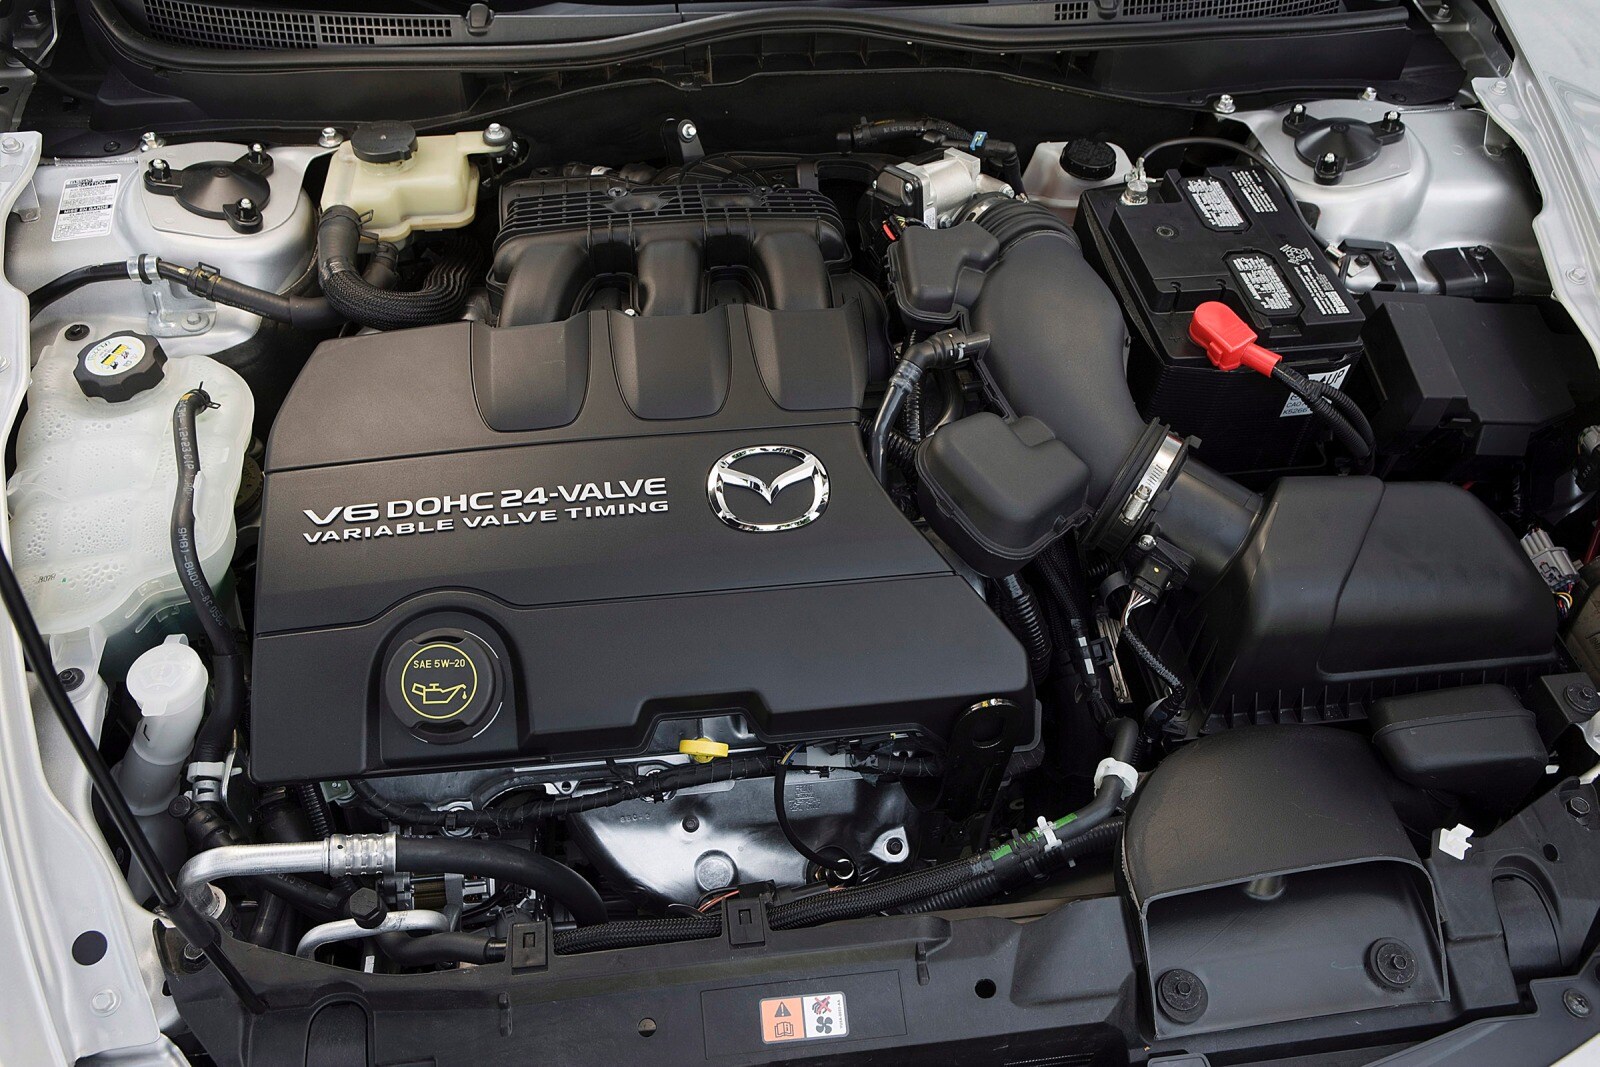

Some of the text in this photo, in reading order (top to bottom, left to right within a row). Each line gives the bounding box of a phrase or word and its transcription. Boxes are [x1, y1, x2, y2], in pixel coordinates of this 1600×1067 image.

[1325, 369, 1346, 386] UP
[303, 477, 668, 526] V6 DOHC 24-VALVE
[303, 500, 669, 544] VARIABLE VALVE TIMING
[413, 658, 466, 669] SAE 5W-20
